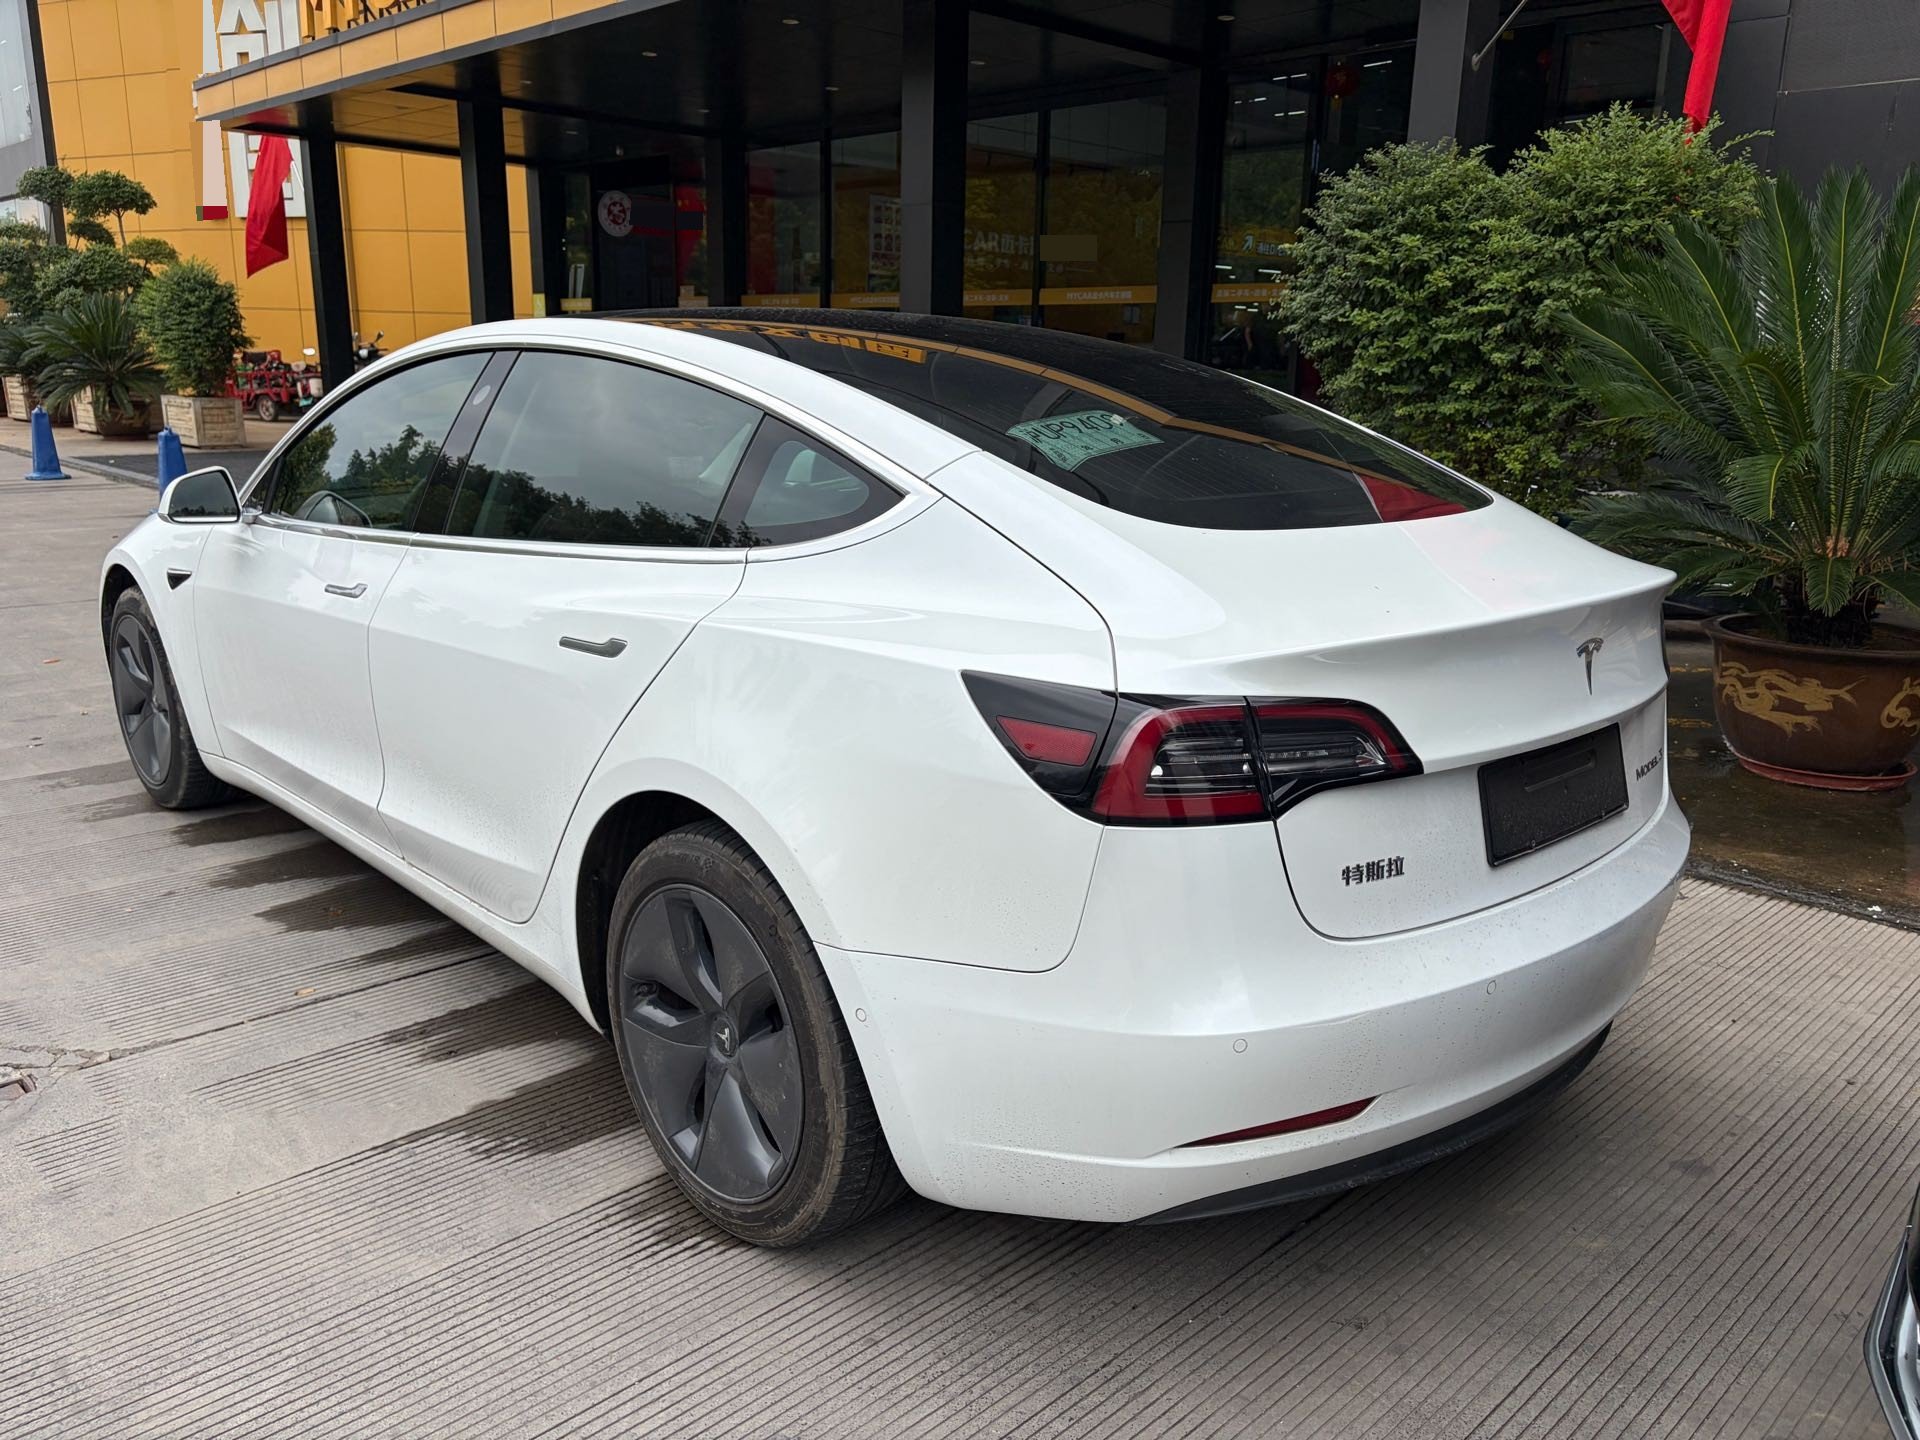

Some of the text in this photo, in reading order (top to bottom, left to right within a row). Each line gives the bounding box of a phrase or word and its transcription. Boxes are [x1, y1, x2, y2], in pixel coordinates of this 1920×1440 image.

[1635, 756, 1659, 782] MODEL
[1341, 855, 1405, 887] 特斯拉
